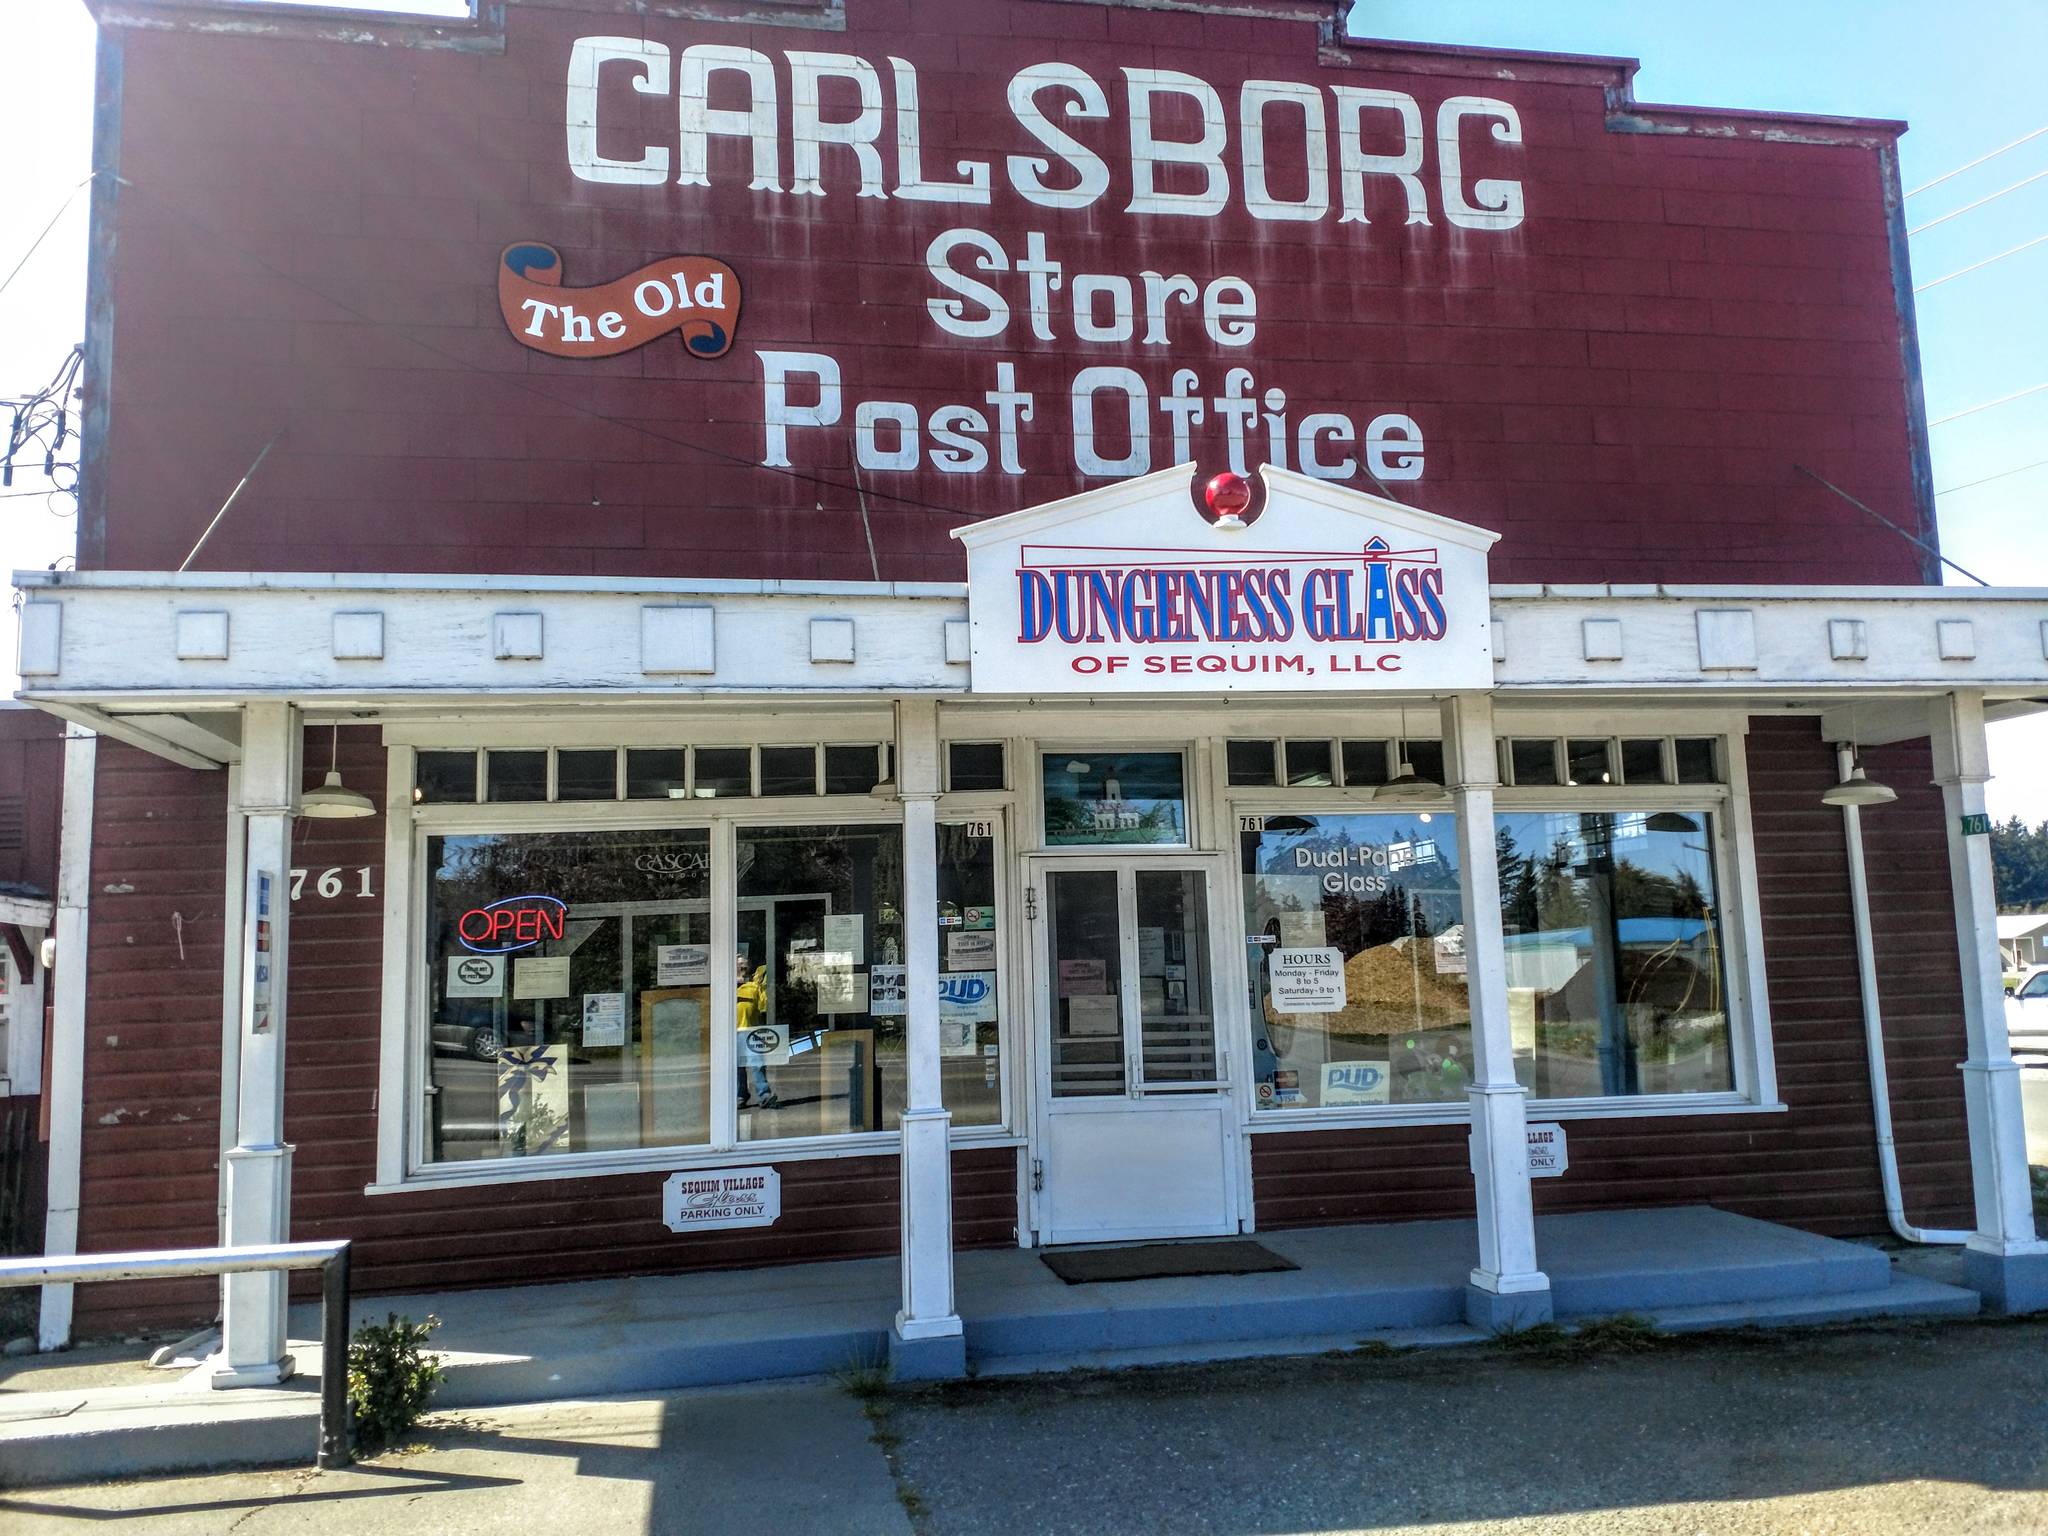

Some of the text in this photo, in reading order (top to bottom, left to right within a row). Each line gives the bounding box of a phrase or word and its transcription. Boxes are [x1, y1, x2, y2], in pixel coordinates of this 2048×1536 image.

[566, 35, 1525, 232] CARLSBORG
[925, 227, 1257, 348] Store
[521, 272, 726, 342] The Old
[755, 349, 1425, 483] Post Office
[1015, 560, 1447, 644] DUNGENESS GLASS
[1071, 654, 1402, 676] OF SEQUIM, LLC
[968, 822, 991, 836] 761
[1240, 816, 1263, 831] 761
[1968, 815, 1987, 832] 761
[1295, 846, 1417, 868] Dual-Pane
[289, 866, 375, 901] 761
[1322, 871, 1387, 892] Glass
[459, 907, 564, 941] OPEN
[1283, 954, 1331, 965] HOURS
[1274, 970, 1307, 978] Monday
[1314, 969, 1340, 977] Friday
[1328, 1067, 1380, 1089] PUD
[1530, 1157, 1555, 1167] ONLY
[681, 1176, 765, 1194] SEQUIM VILLAGE
[680, 1205, 765, 1220] PARKING ONLY
